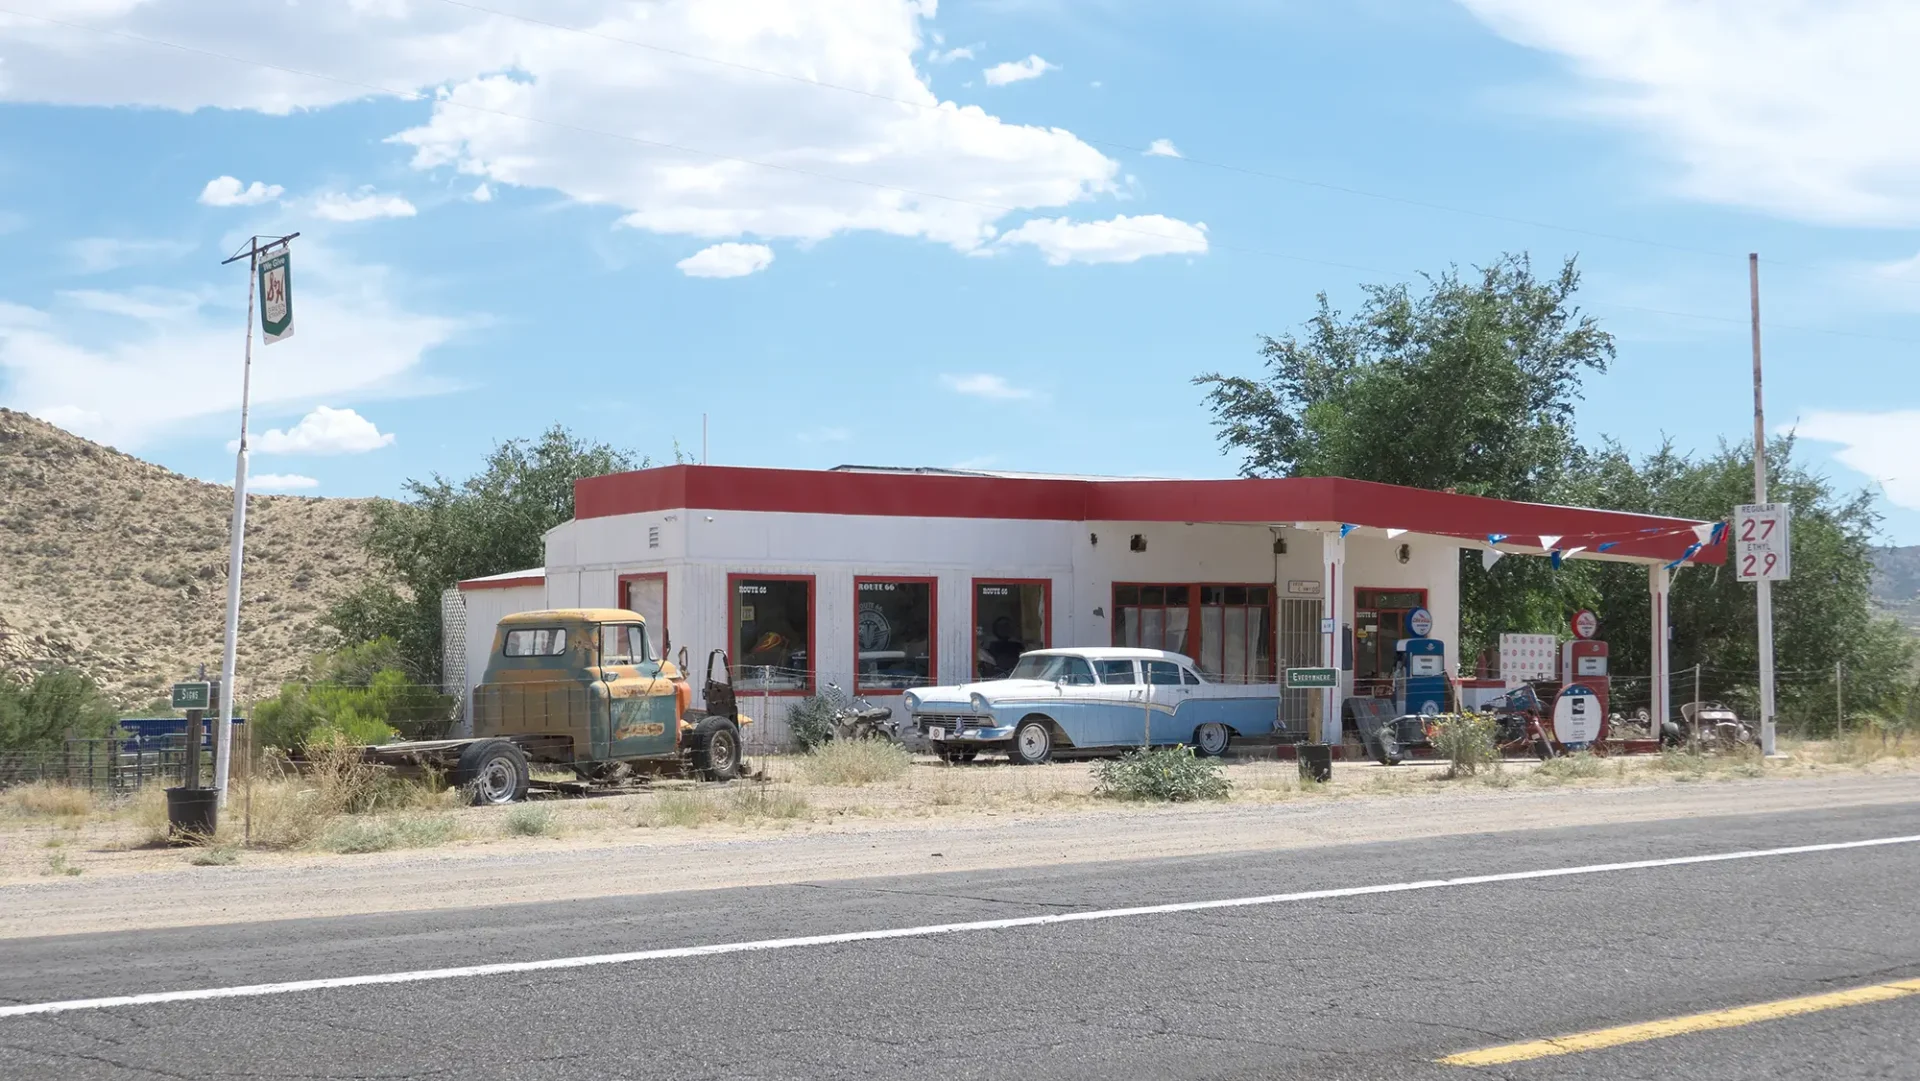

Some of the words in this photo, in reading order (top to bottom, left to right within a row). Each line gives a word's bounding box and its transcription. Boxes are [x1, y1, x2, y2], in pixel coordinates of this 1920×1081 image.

[263, 262, 272, 271] We
[272, 258, 285, 267] Give
[1741, 504, 1776, 513] REGULAR
[1741, 518, 1776, 542] 27
[1747, 543, 1771, 552] ETHYL
[1742, 553, 1777, 577] 29
[738, 585, 759, 594] ROUTE
[759, 586, 767, 594] 66
[858, 583, 883, 591] ROUTE
[884, 583, 895, 591] 66
[982, 587, 1001, 595] ROUTE
[1001, 587, 1008, 595] 66
[858, 601, 875, 610] OUTE
